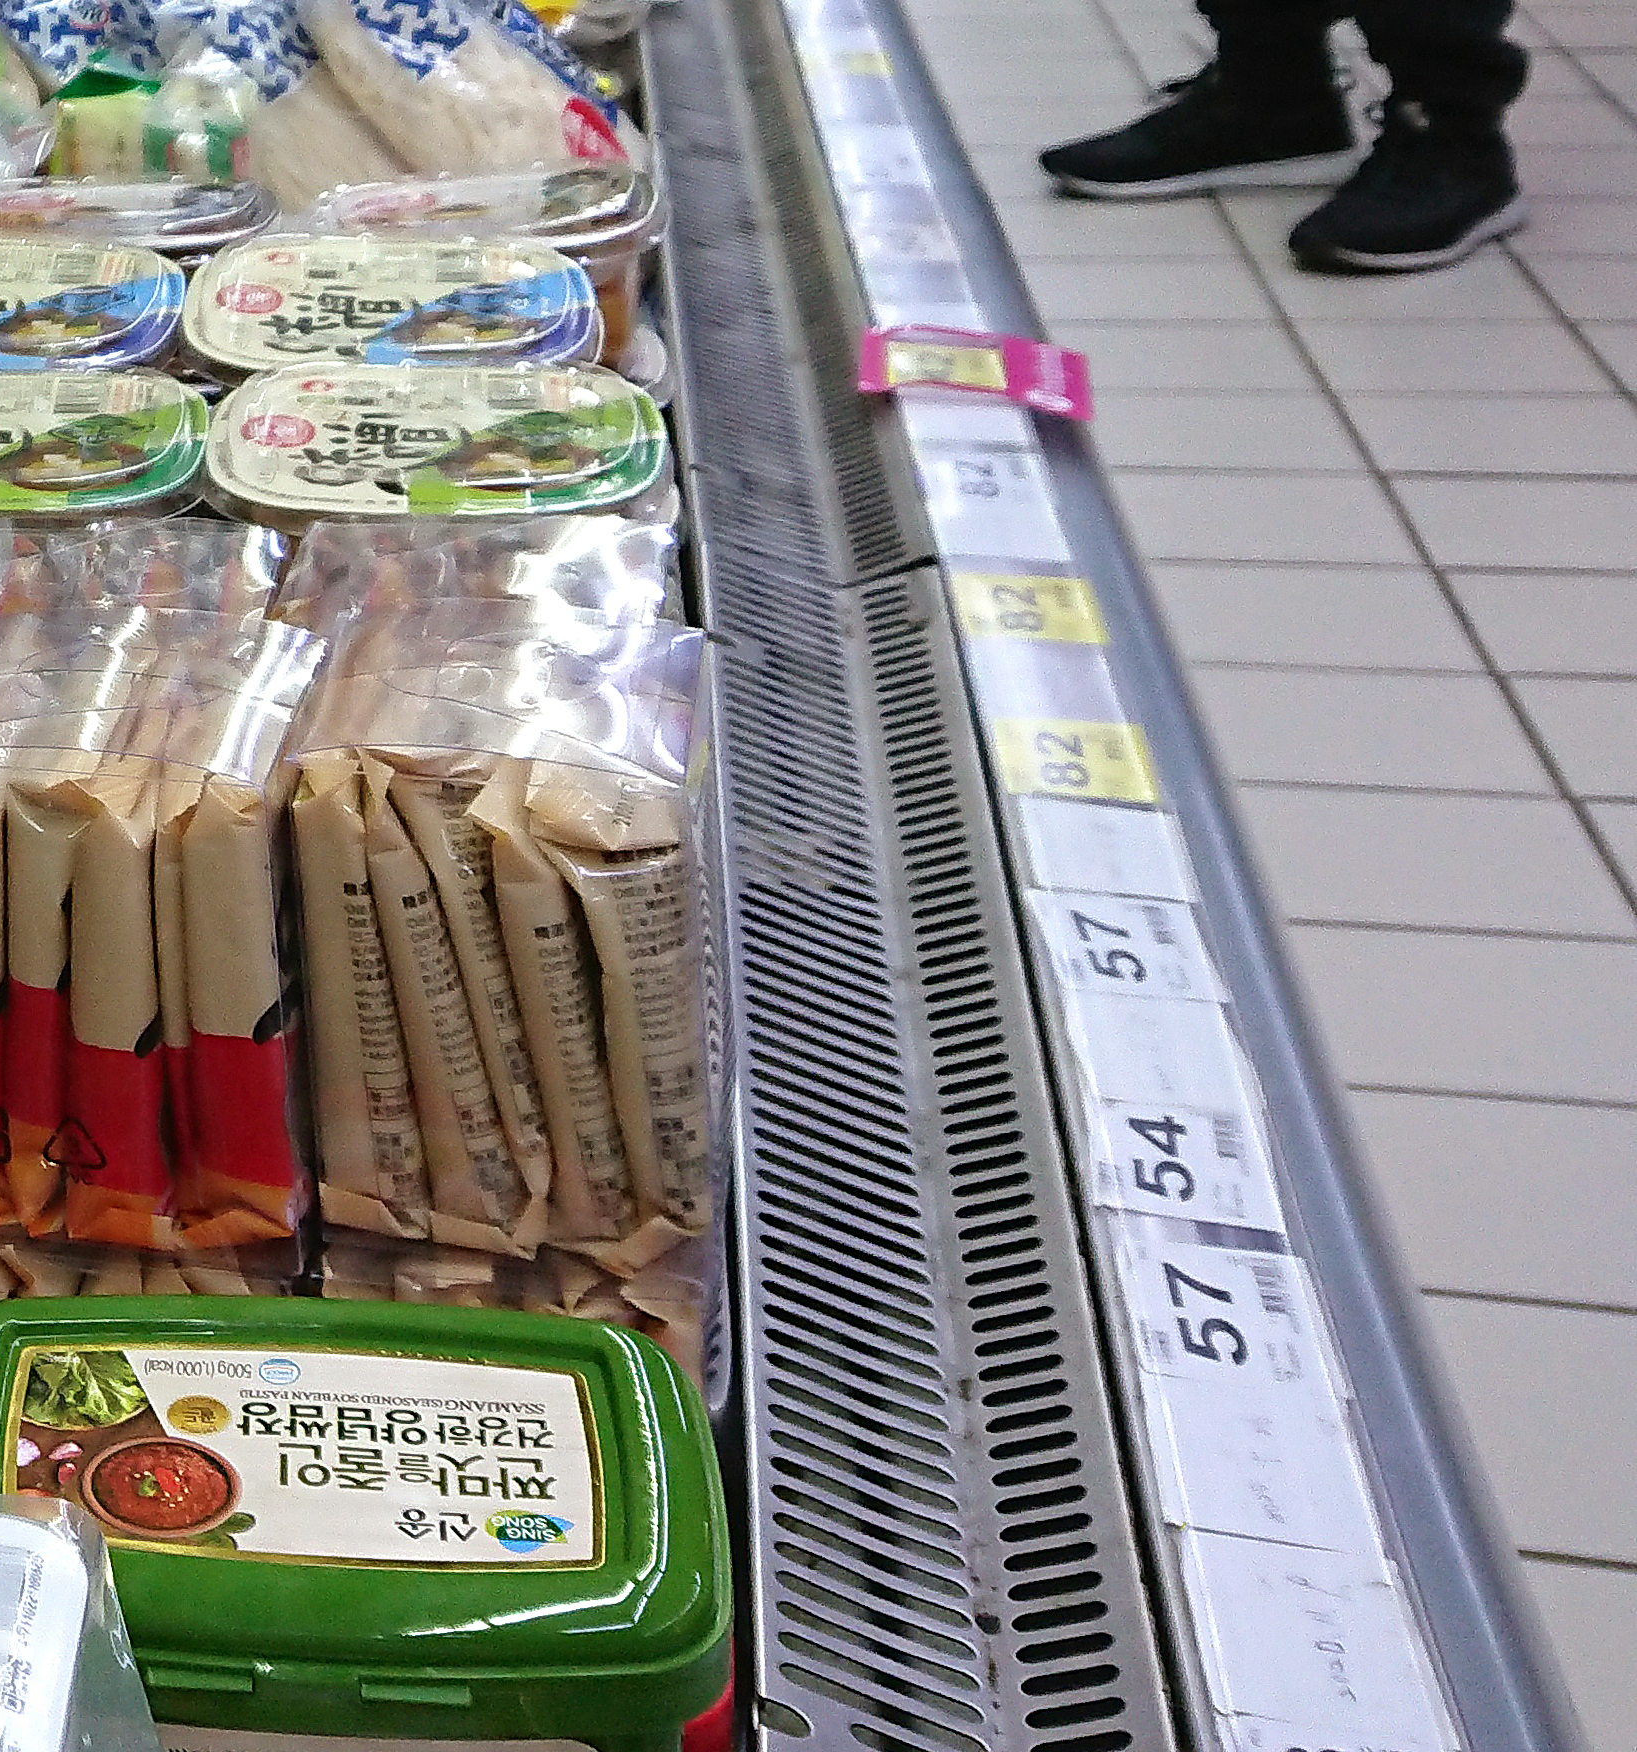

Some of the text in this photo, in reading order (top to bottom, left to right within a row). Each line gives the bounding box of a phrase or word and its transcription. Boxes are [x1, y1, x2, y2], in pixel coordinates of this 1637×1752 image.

[1071, 910, 1146, 983] 57
[1128, 1115, 1194, 1202] 54
[1163, 1263, 1248, 1366] 57
[144, 1359, 253, 1380] 500g (1,000 kcal)
[236, 1401, 554, 1451] 건강한 양념쌈장
[277, 1442, 558, 1502] 짠맛을 줄인
[394, 1509, 478, 1544] 신송
[490, 1514, 548, 1529] SONG
[504, 1526, 558, 1542] SING
